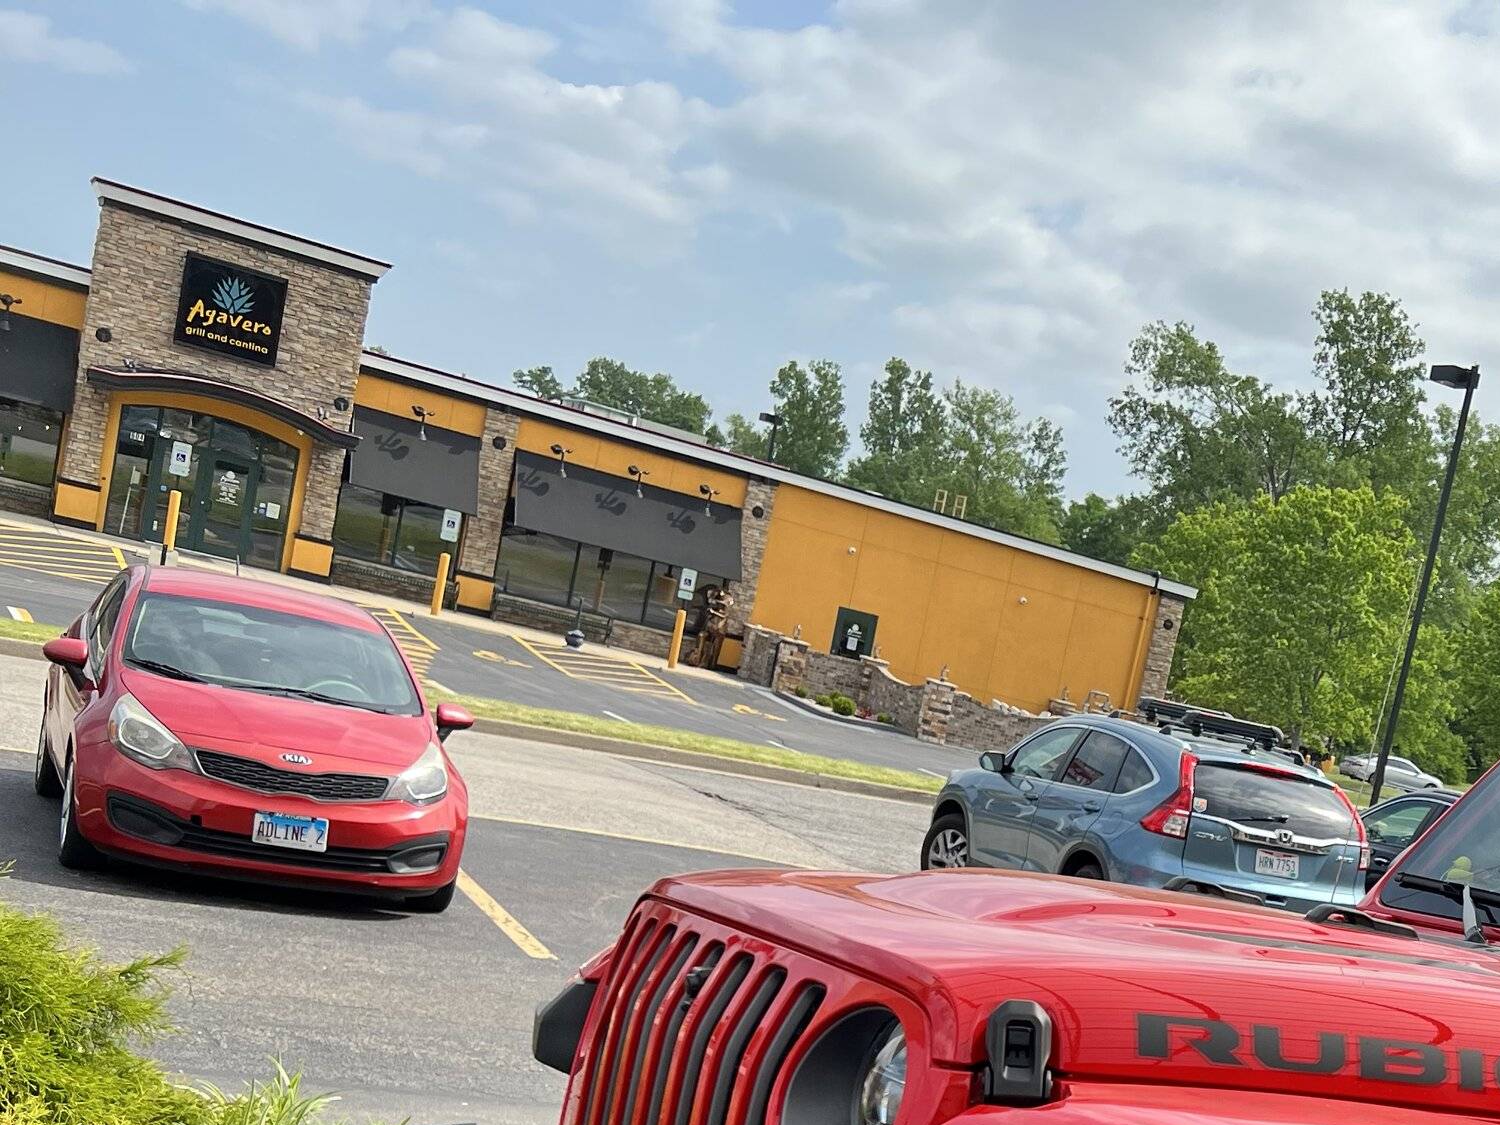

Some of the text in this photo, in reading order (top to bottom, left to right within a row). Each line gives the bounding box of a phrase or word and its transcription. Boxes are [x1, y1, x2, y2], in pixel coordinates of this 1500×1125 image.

[187, 299, 272, 336] Agavero
[185, 326, 269, 355] grill and cantina
[285, 753, 308, 765] KIA
[257, 820, 308, 843] ADLINE
